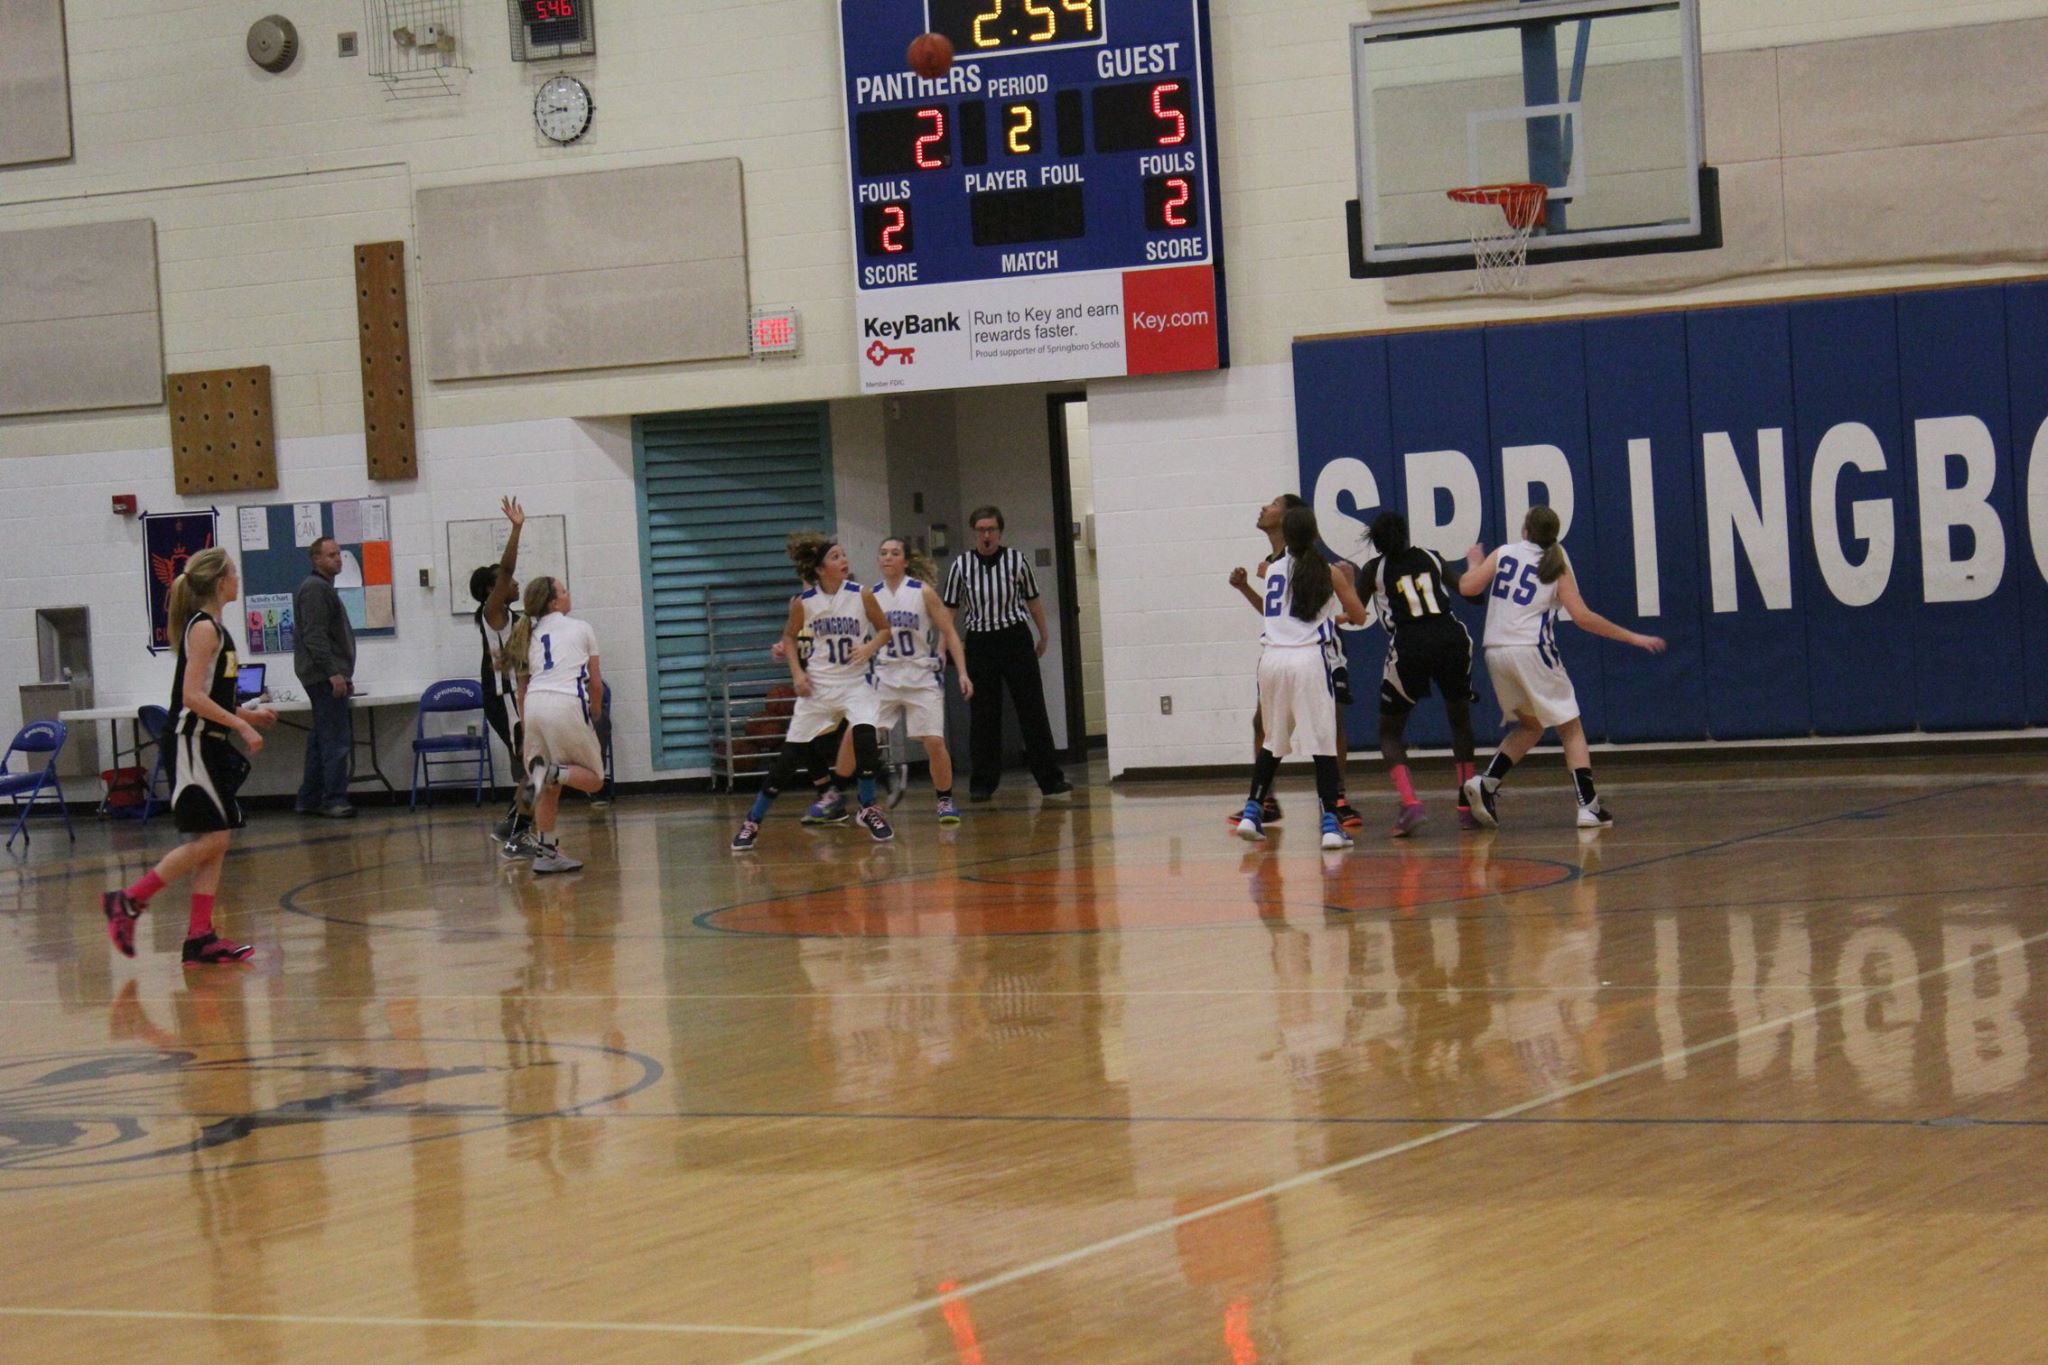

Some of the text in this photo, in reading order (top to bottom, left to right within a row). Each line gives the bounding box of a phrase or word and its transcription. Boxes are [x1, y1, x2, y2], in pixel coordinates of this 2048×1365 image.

[1097, 43, 1180, 78] GUEST
[856, 64, 982, 104] PANTHERS
[988, 74, 1049, 99] PERIOD
[1153, 84, 1185, 144] 5
[915, 109, 943, 169] 2
[1009, 106, 1032, 152] 2
[964, 164, 1085, 193] PLAYER FOUL
[1140, 152, 1195, 176] FOULS
[859, 180, 911, 203] FOULS
[1165, 179, 1188, 226] 2
[882, 206, 904, 252] 2
[1001, 250, 1059, 273] MATCH
[1145, 238, 1203, 261] SCORE
[864, 262, 918, 286] SCORE
[864, 312, 961, 340] KeyBank
[974, 304, 1119, 325] Run to Key and earn
[1132, 309, 1209, 333] Key.com
[975, 324, 1078, 343] rewards faster.
[975, 339, 1120, 358] Proud supporter of Springboro Schools
[1313, 413, 2048, 631] SPRINGB
[1396, 572, 1441, 618] 11
[1492, 555, 1540, 606] 25
[541, 633, 555, 670] 1
[826, 636, 854, 665] 10
